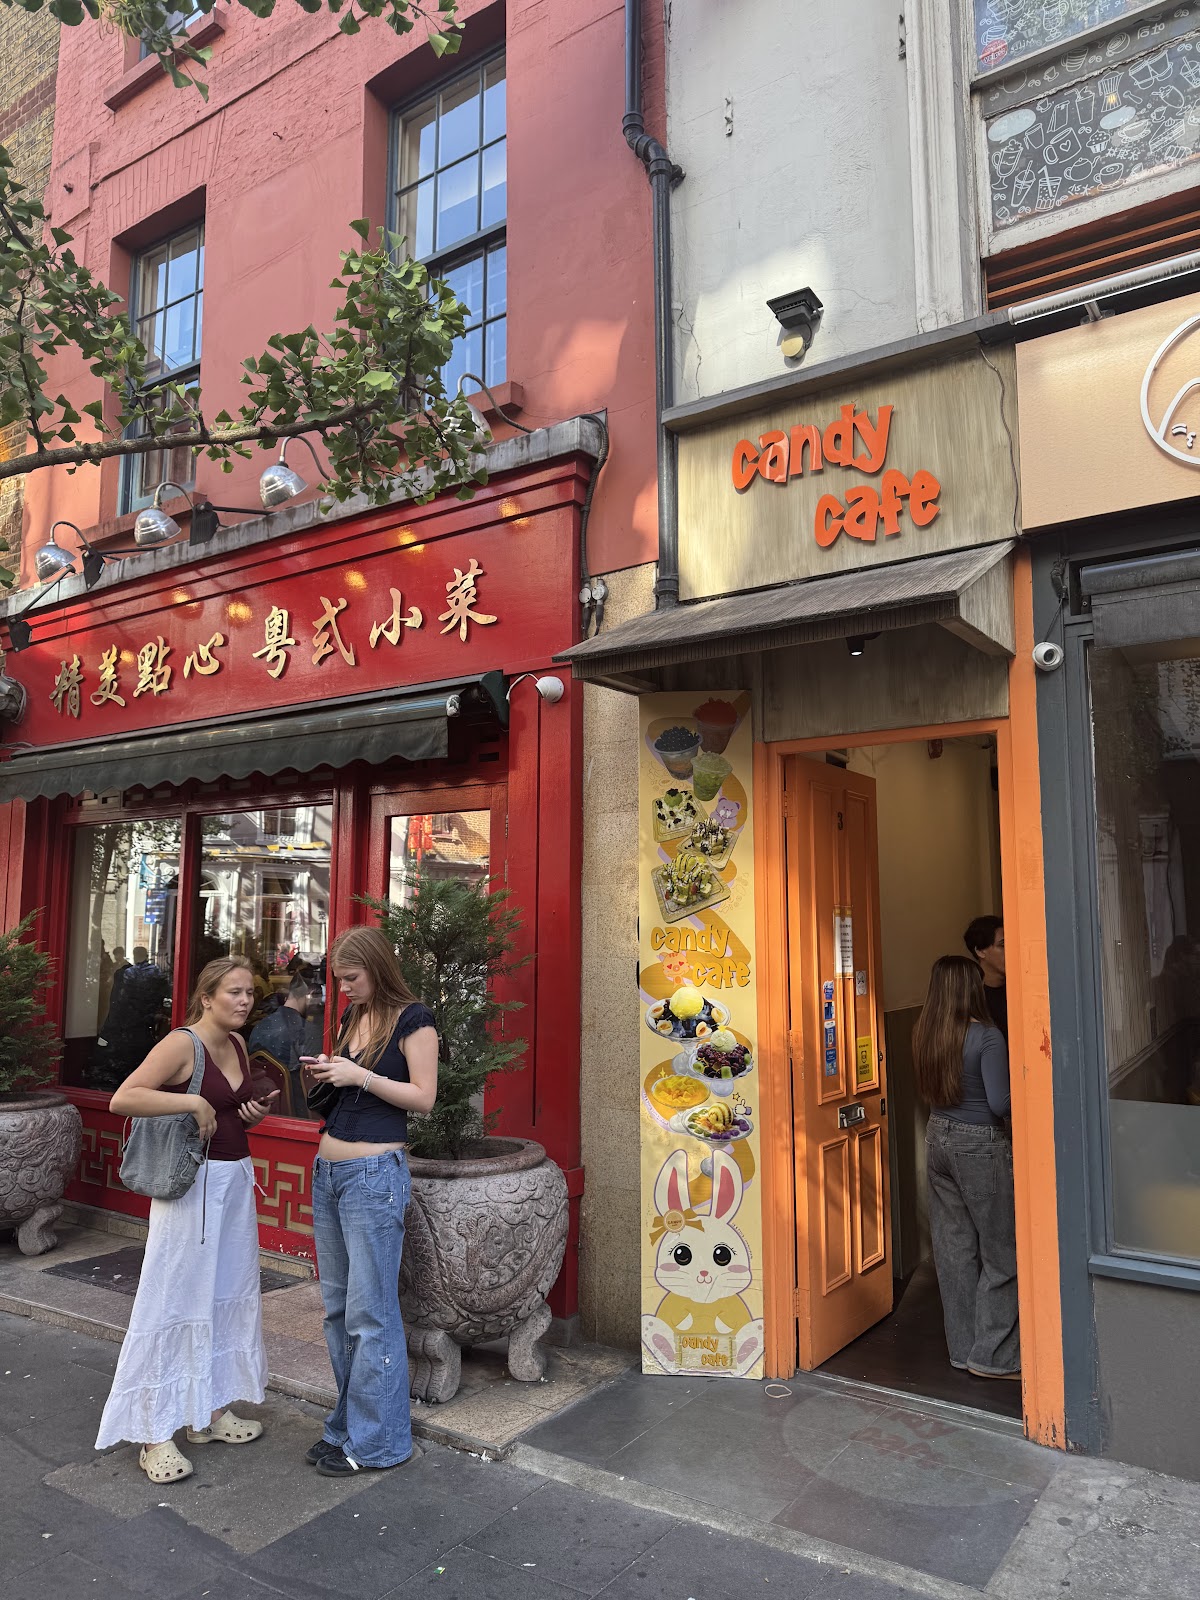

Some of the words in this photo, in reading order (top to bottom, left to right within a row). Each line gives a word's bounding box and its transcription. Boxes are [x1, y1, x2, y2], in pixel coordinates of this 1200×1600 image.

[731, 403, 895, 490] candy
[814, 469, 941, 547] cafe
[650, 924, 731, 958] candy
[692, 960, 751, 988] cafe
[682, 1336, 719, 1353] candy
[701, 1353, 729, 1367] cafe
